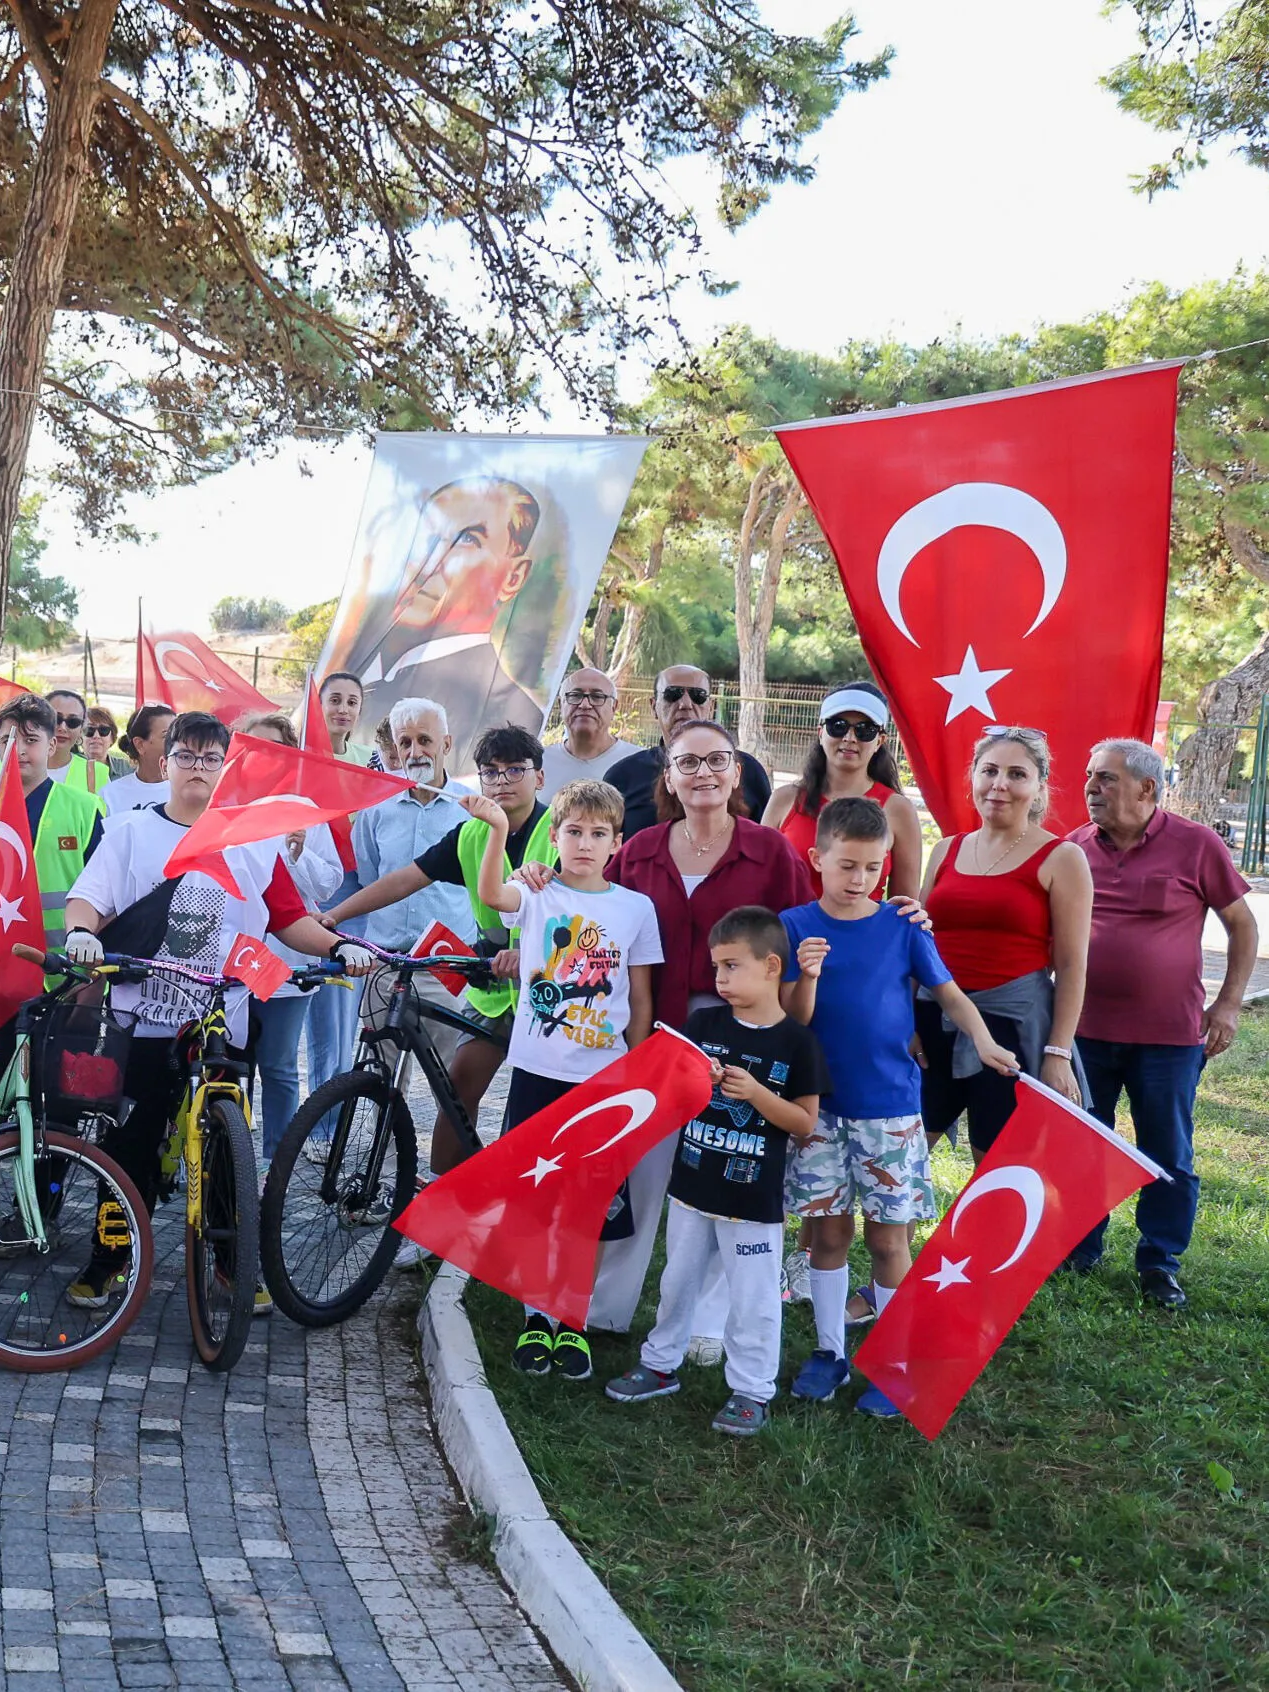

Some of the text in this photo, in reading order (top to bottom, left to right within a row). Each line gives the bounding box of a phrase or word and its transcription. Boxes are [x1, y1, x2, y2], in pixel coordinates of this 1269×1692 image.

[586, 950, 621, 959] LIMITED
[590, 960, 620, 969] EDITION
[566, 1004, 608, 1028] EPIC
[562, 1026, 618, 1048] VIBES
[685, 1119, 766, 1156] AWESOME
[736, 1242, 772, 1256] SCHOOL
[526, 1333, 547, 1341] NIKE
[559, 1334, 579, 1344] NIKE
